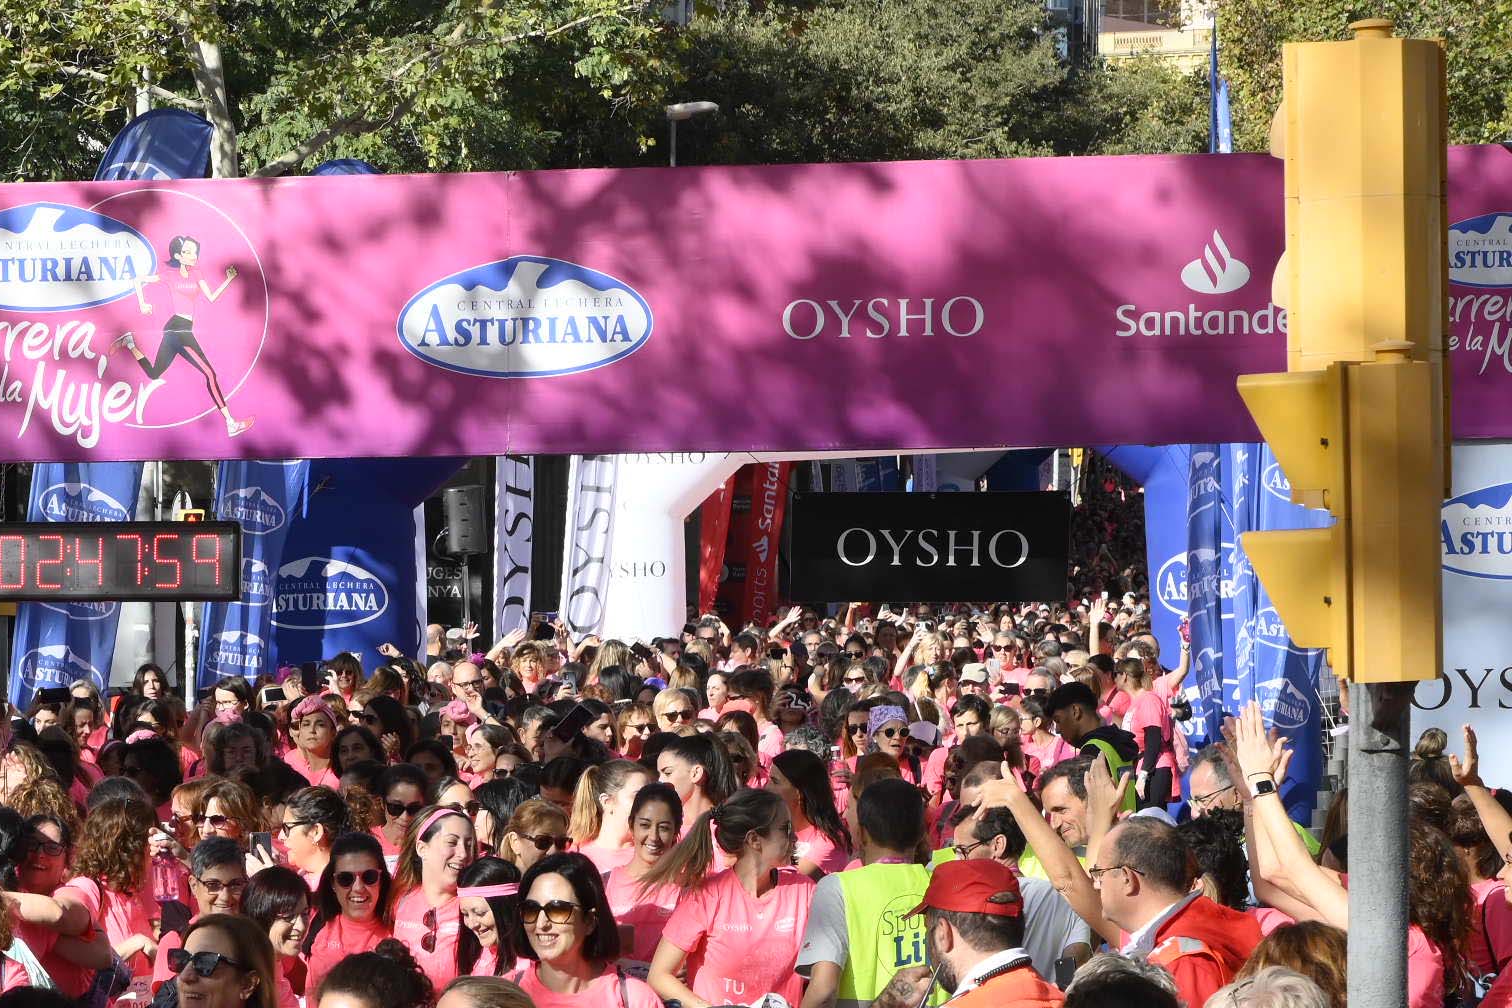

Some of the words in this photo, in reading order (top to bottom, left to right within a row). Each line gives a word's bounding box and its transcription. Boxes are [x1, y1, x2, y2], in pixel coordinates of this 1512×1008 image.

[61, 240, 134, 251] LECHERA
[457, 299, 535, 311] CENTRAL
[542, 297, 624, 309] LECHERA
[782, 296, 985, 340] OYSHO
[1116, 302, 1288, 337] Santande
[417, 303, 632, 348] ASTURIANA
[17, 354, 166, 448] Mujer
[837, 527, 1029, 568] OYSHO
[326, 581, 374, 589] LECHERA
[724, 978, 745, 995] TU
